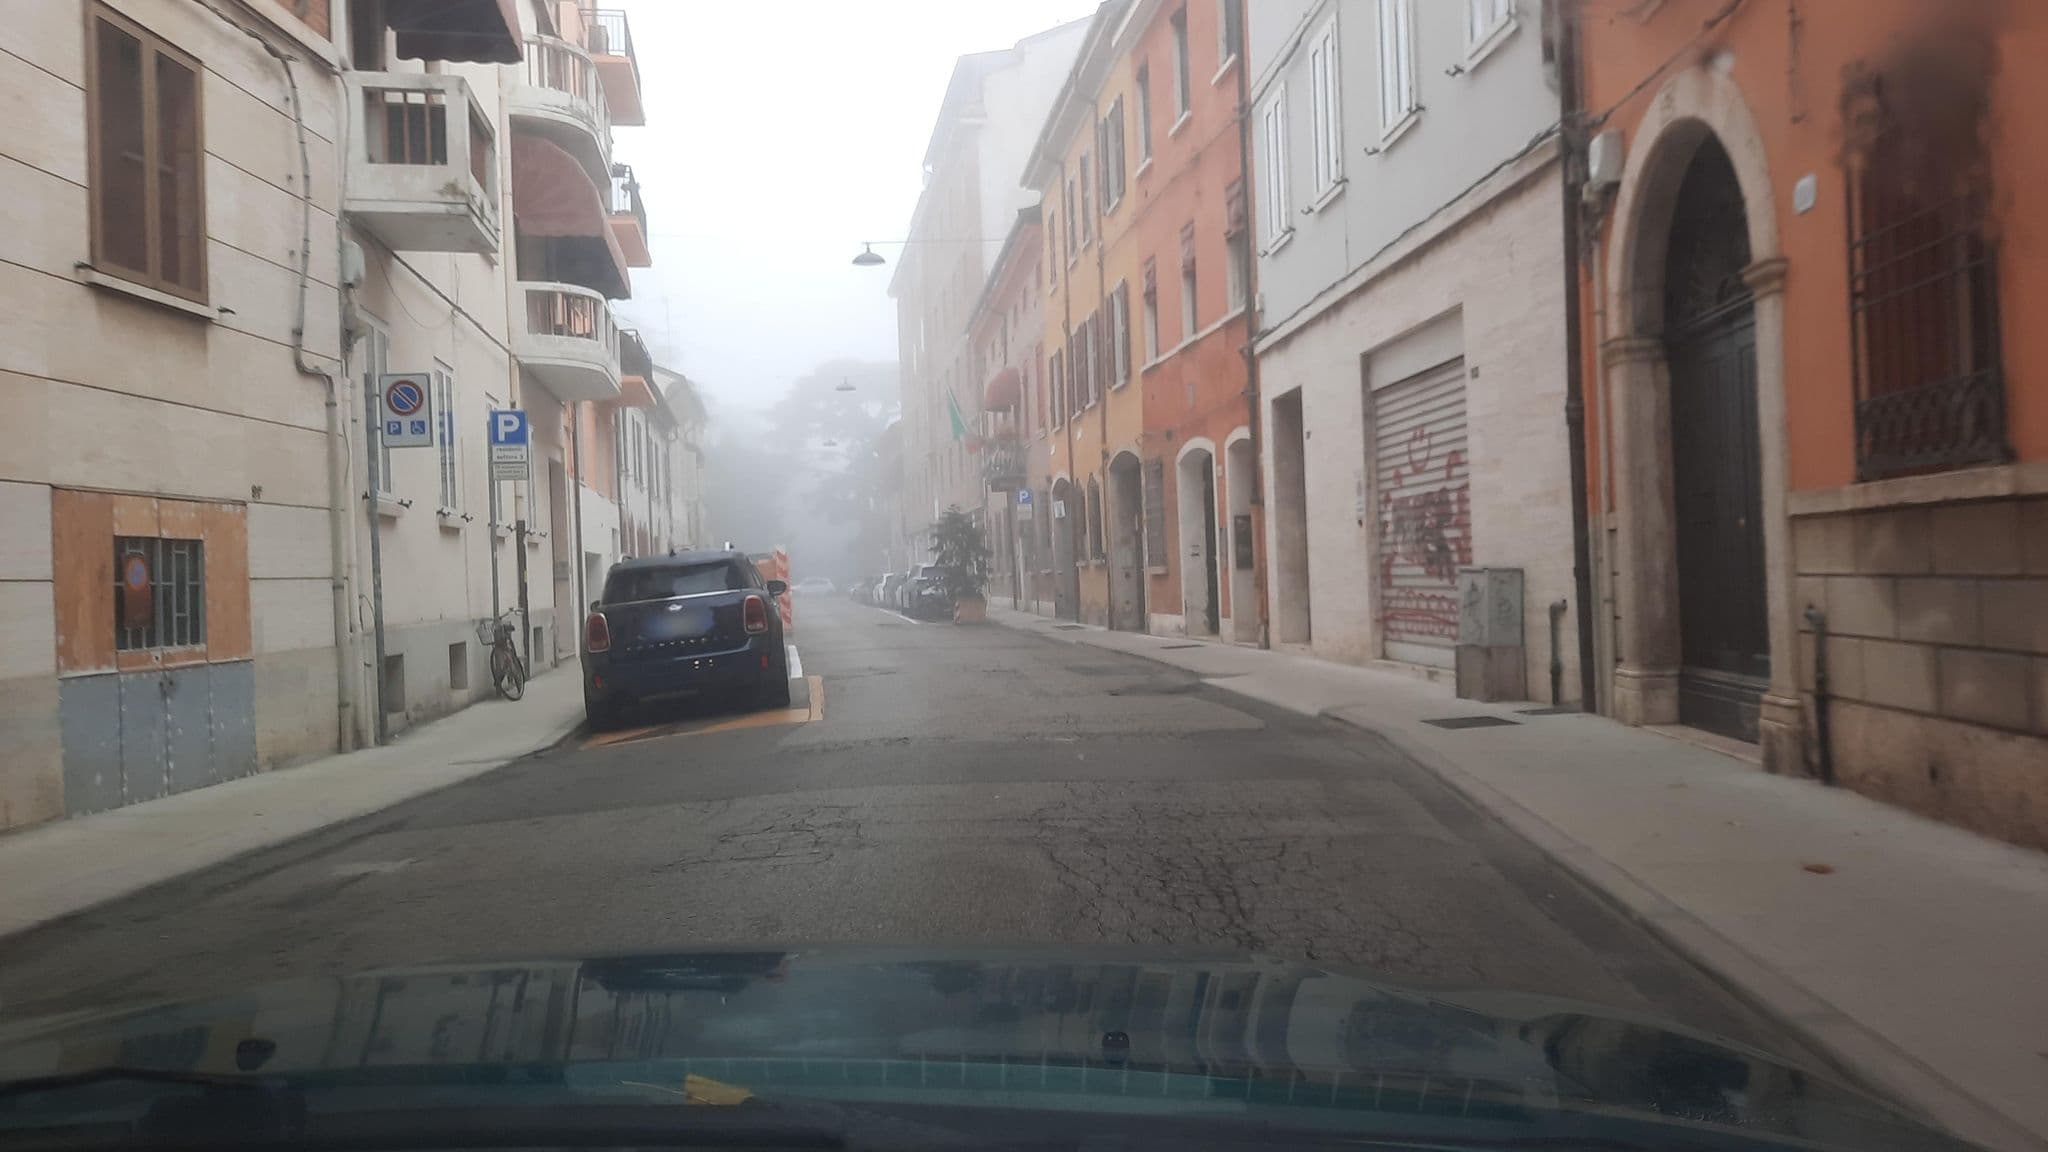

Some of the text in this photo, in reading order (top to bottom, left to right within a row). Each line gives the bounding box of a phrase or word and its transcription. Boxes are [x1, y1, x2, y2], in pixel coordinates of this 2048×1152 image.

[390, 423, 399, 433] P
[498, 414, 520, 442] P
[1019, 490, 1029, 503] P
